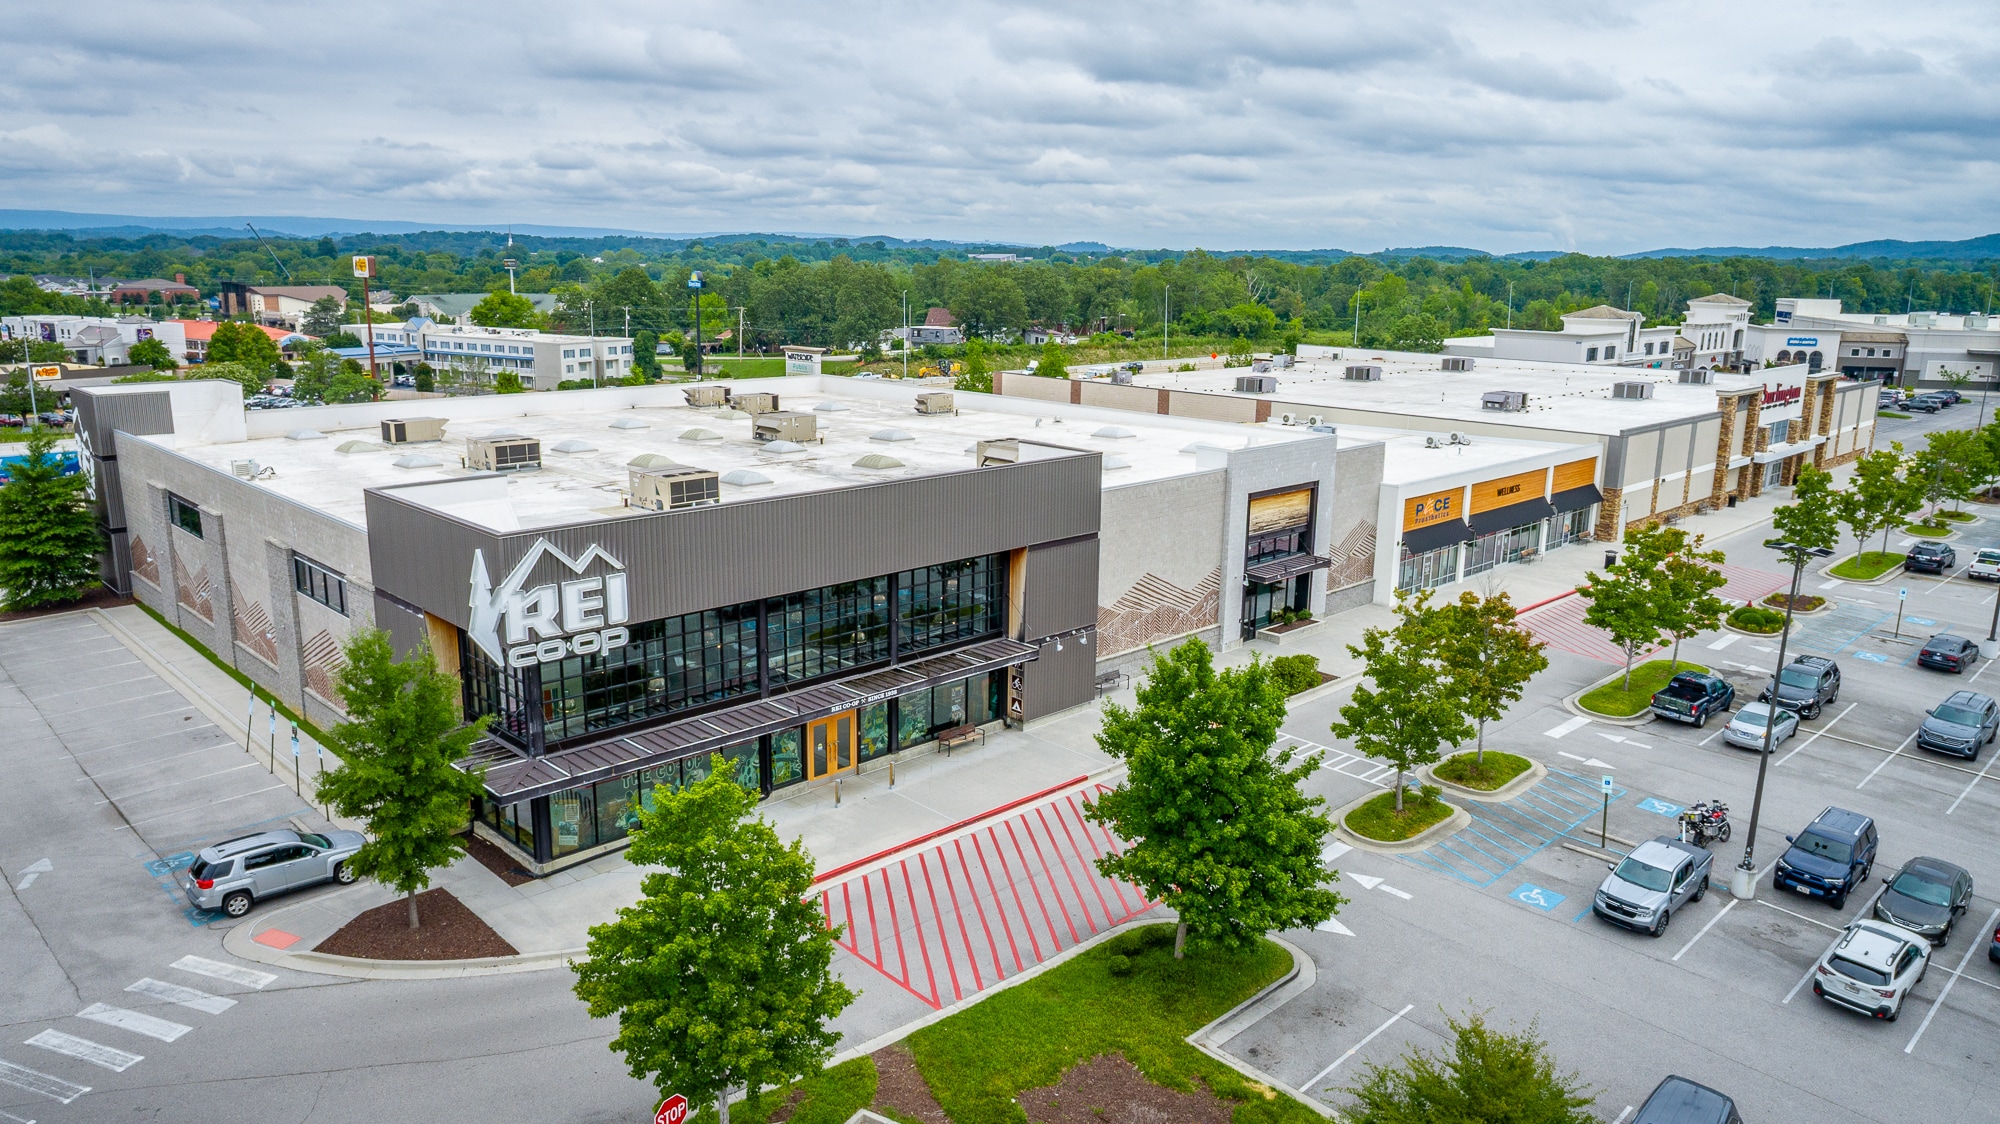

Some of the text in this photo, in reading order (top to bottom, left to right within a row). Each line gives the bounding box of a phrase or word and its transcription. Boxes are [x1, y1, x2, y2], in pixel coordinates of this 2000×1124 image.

[1760, 383, 1801, 407] Burlington
[1497, 484, 1520, 497] WELLNESS
[506, 573, 629, 644] REI
[831, 705, 842, 713] REI
[843, 700, 859, 709] CO-OP
[868, 692, 885, 702] SINCE
[622, 754, 704, 789] THE CO-OP
[657, 1102, 685, 1124] STOP
